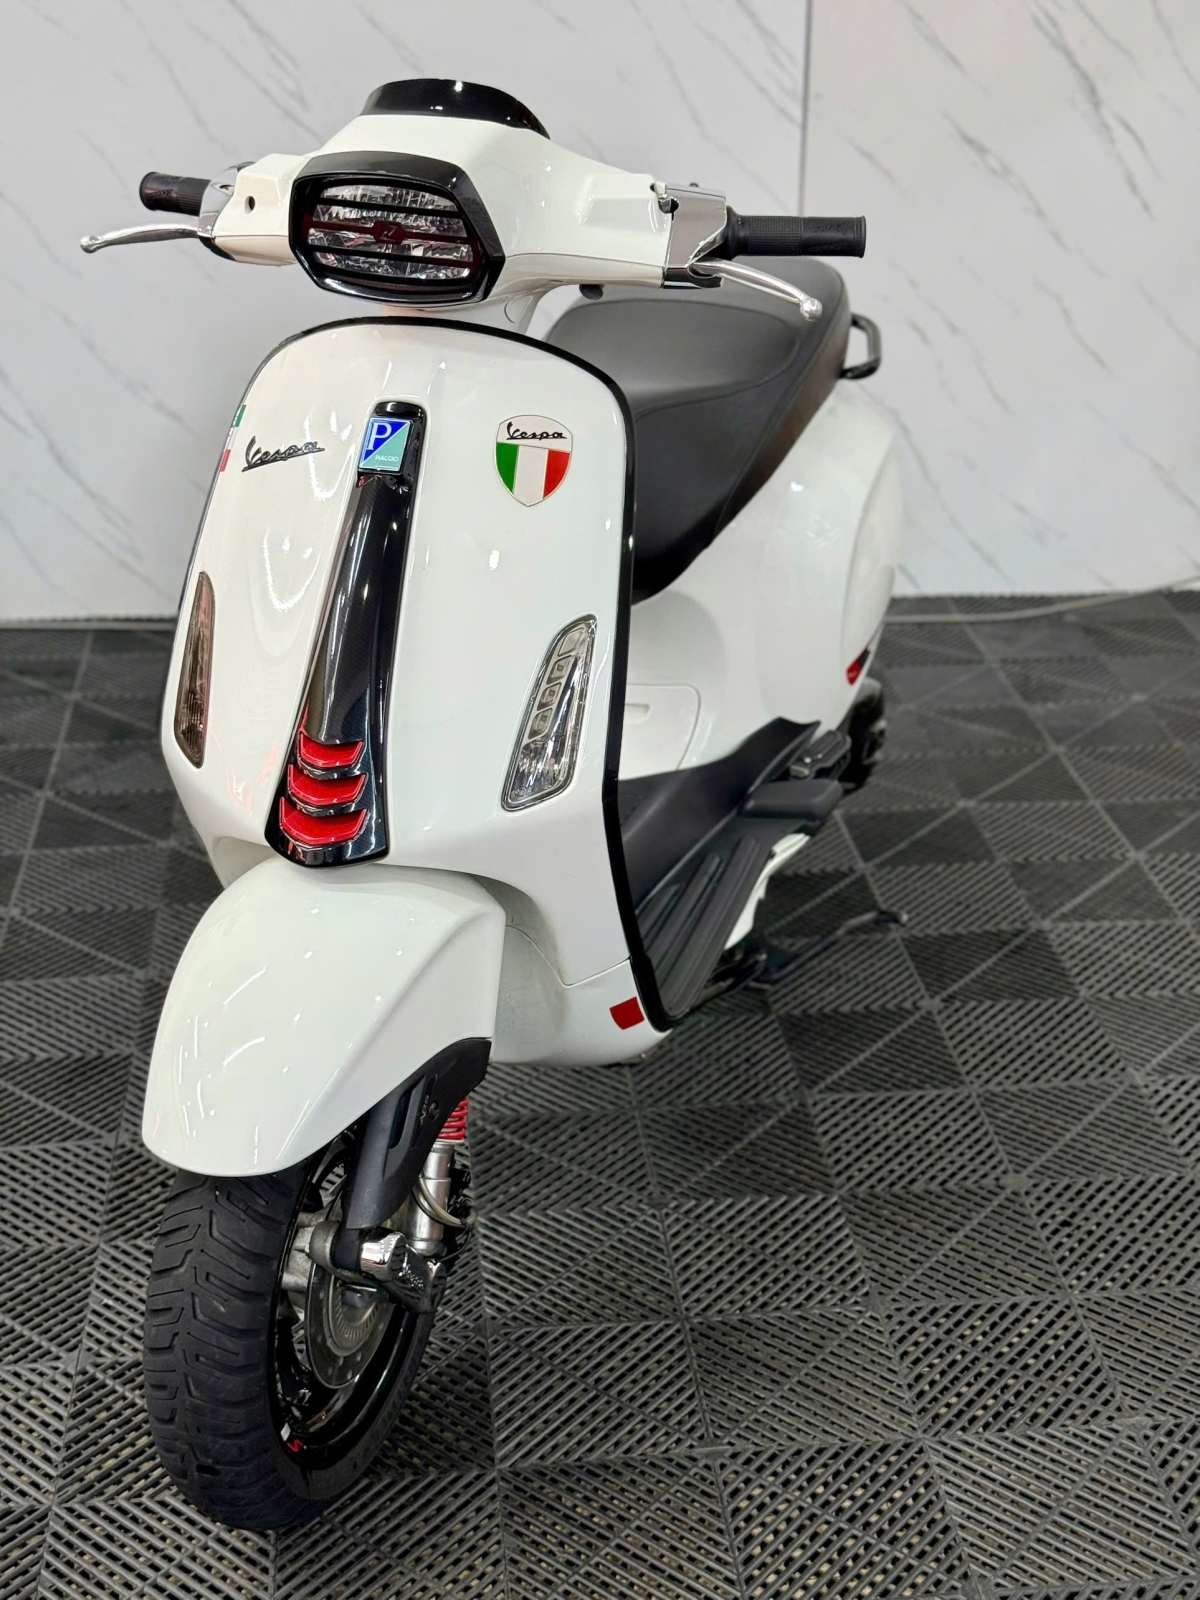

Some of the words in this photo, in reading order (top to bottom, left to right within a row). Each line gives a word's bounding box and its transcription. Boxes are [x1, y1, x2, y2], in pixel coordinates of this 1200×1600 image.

[366, 422, 393, 451] P
[506, 421, 567, 441] Vespa
[241, 435, 325, 472] Vespa
[374, 454, 399, 462] PIAGGIO
